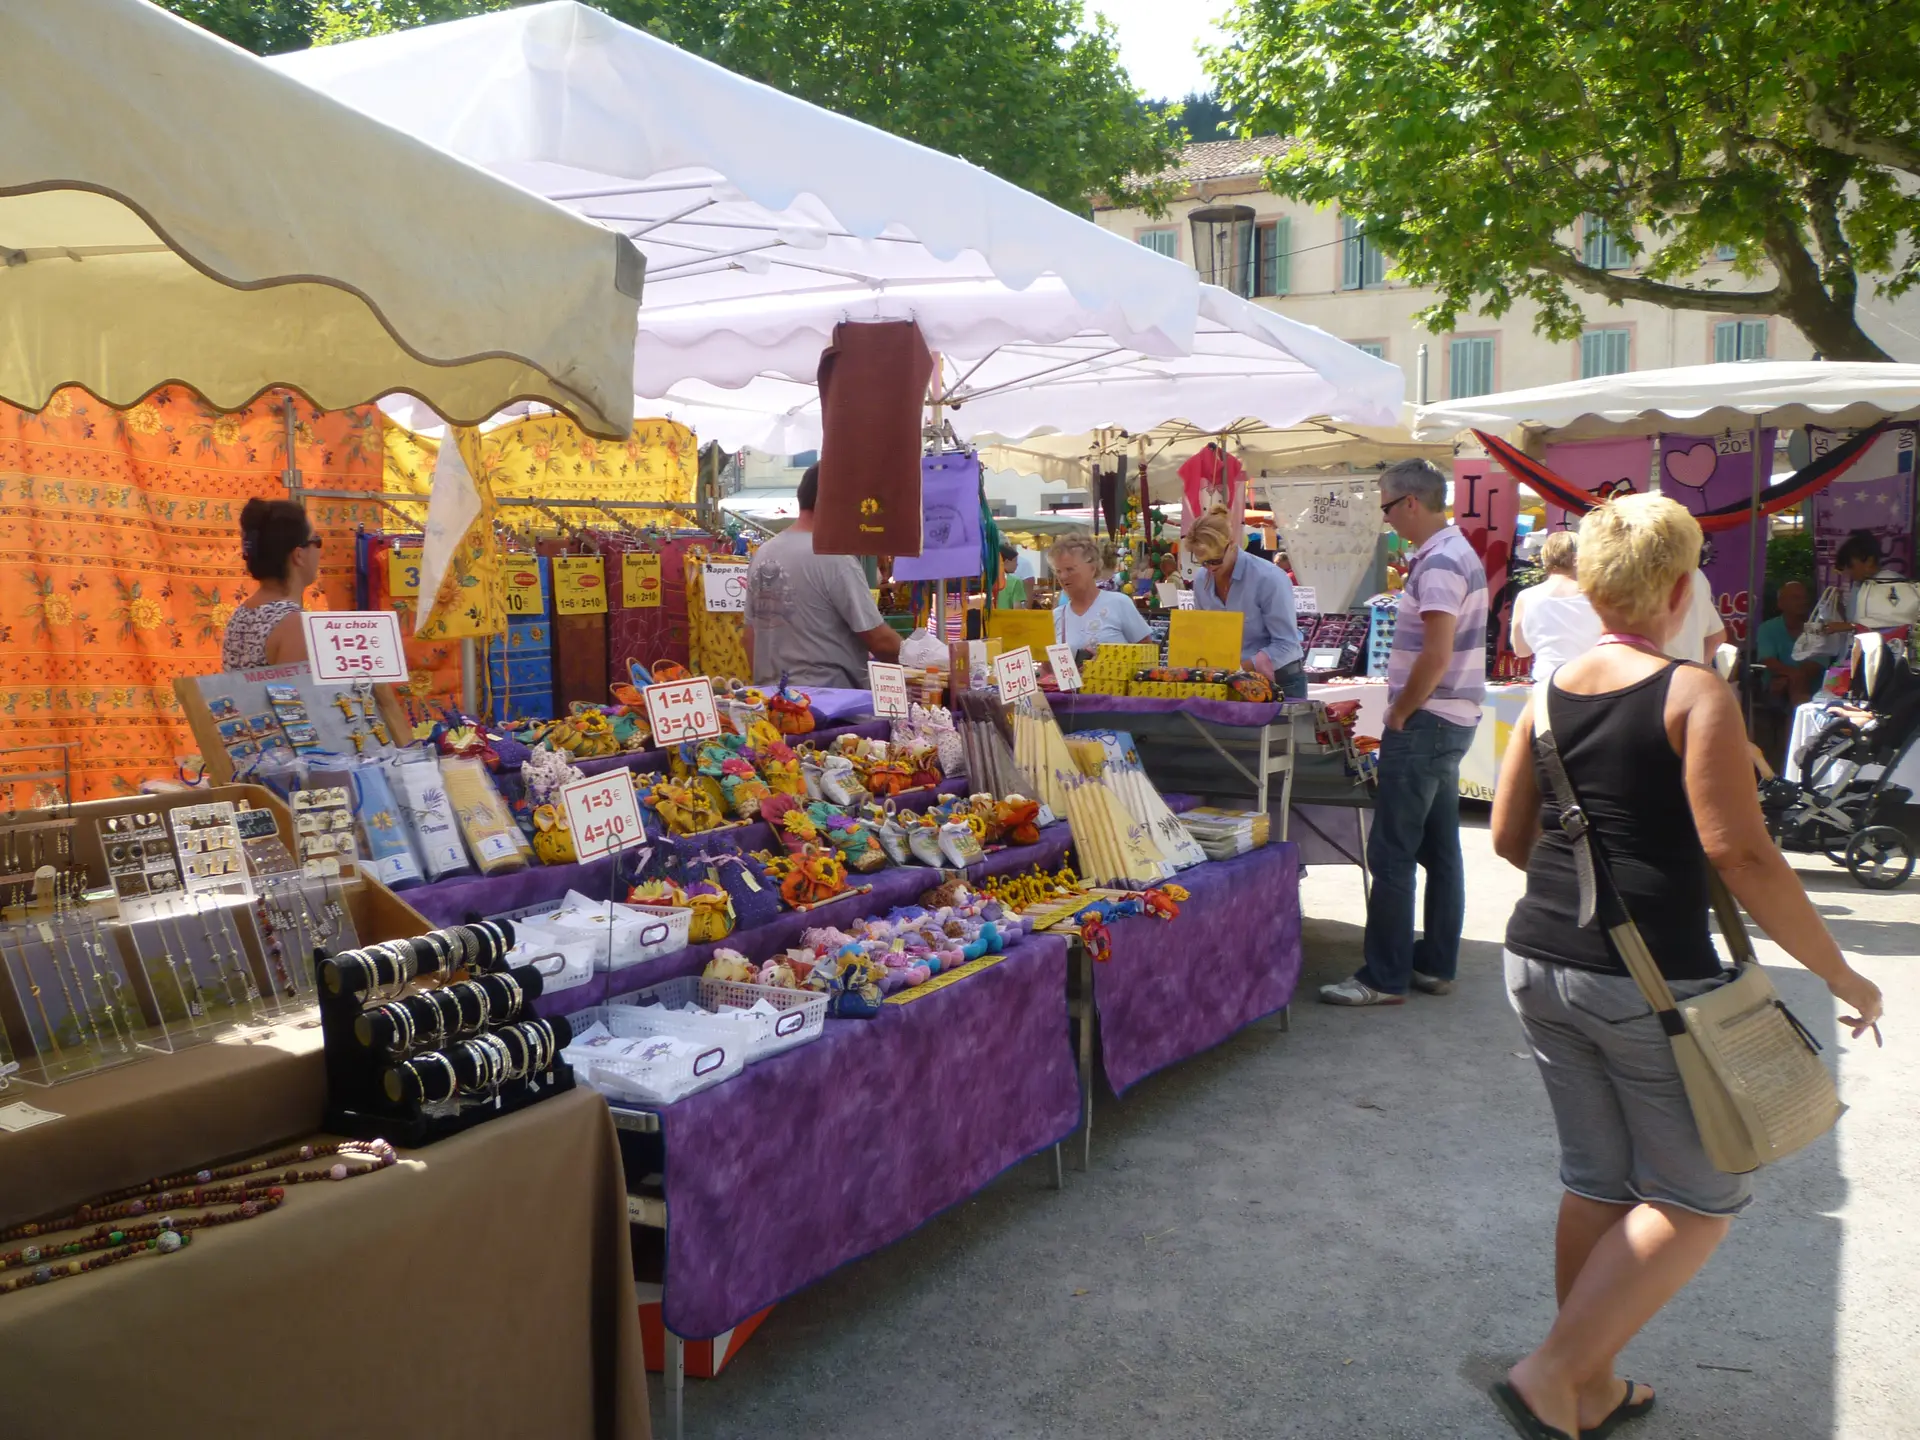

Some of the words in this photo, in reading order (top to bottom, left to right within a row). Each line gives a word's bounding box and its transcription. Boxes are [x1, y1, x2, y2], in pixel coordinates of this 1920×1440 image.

[1815, 436, 1829, 457] 50
[1313, 496, 1349, 509] RIDEAU
[706, 566, 732, 574] Nappe
[325, 621, 341, 630] Au
[345, 620, 378, 630] choix
[244, 665, 300, 683] MAGNET
